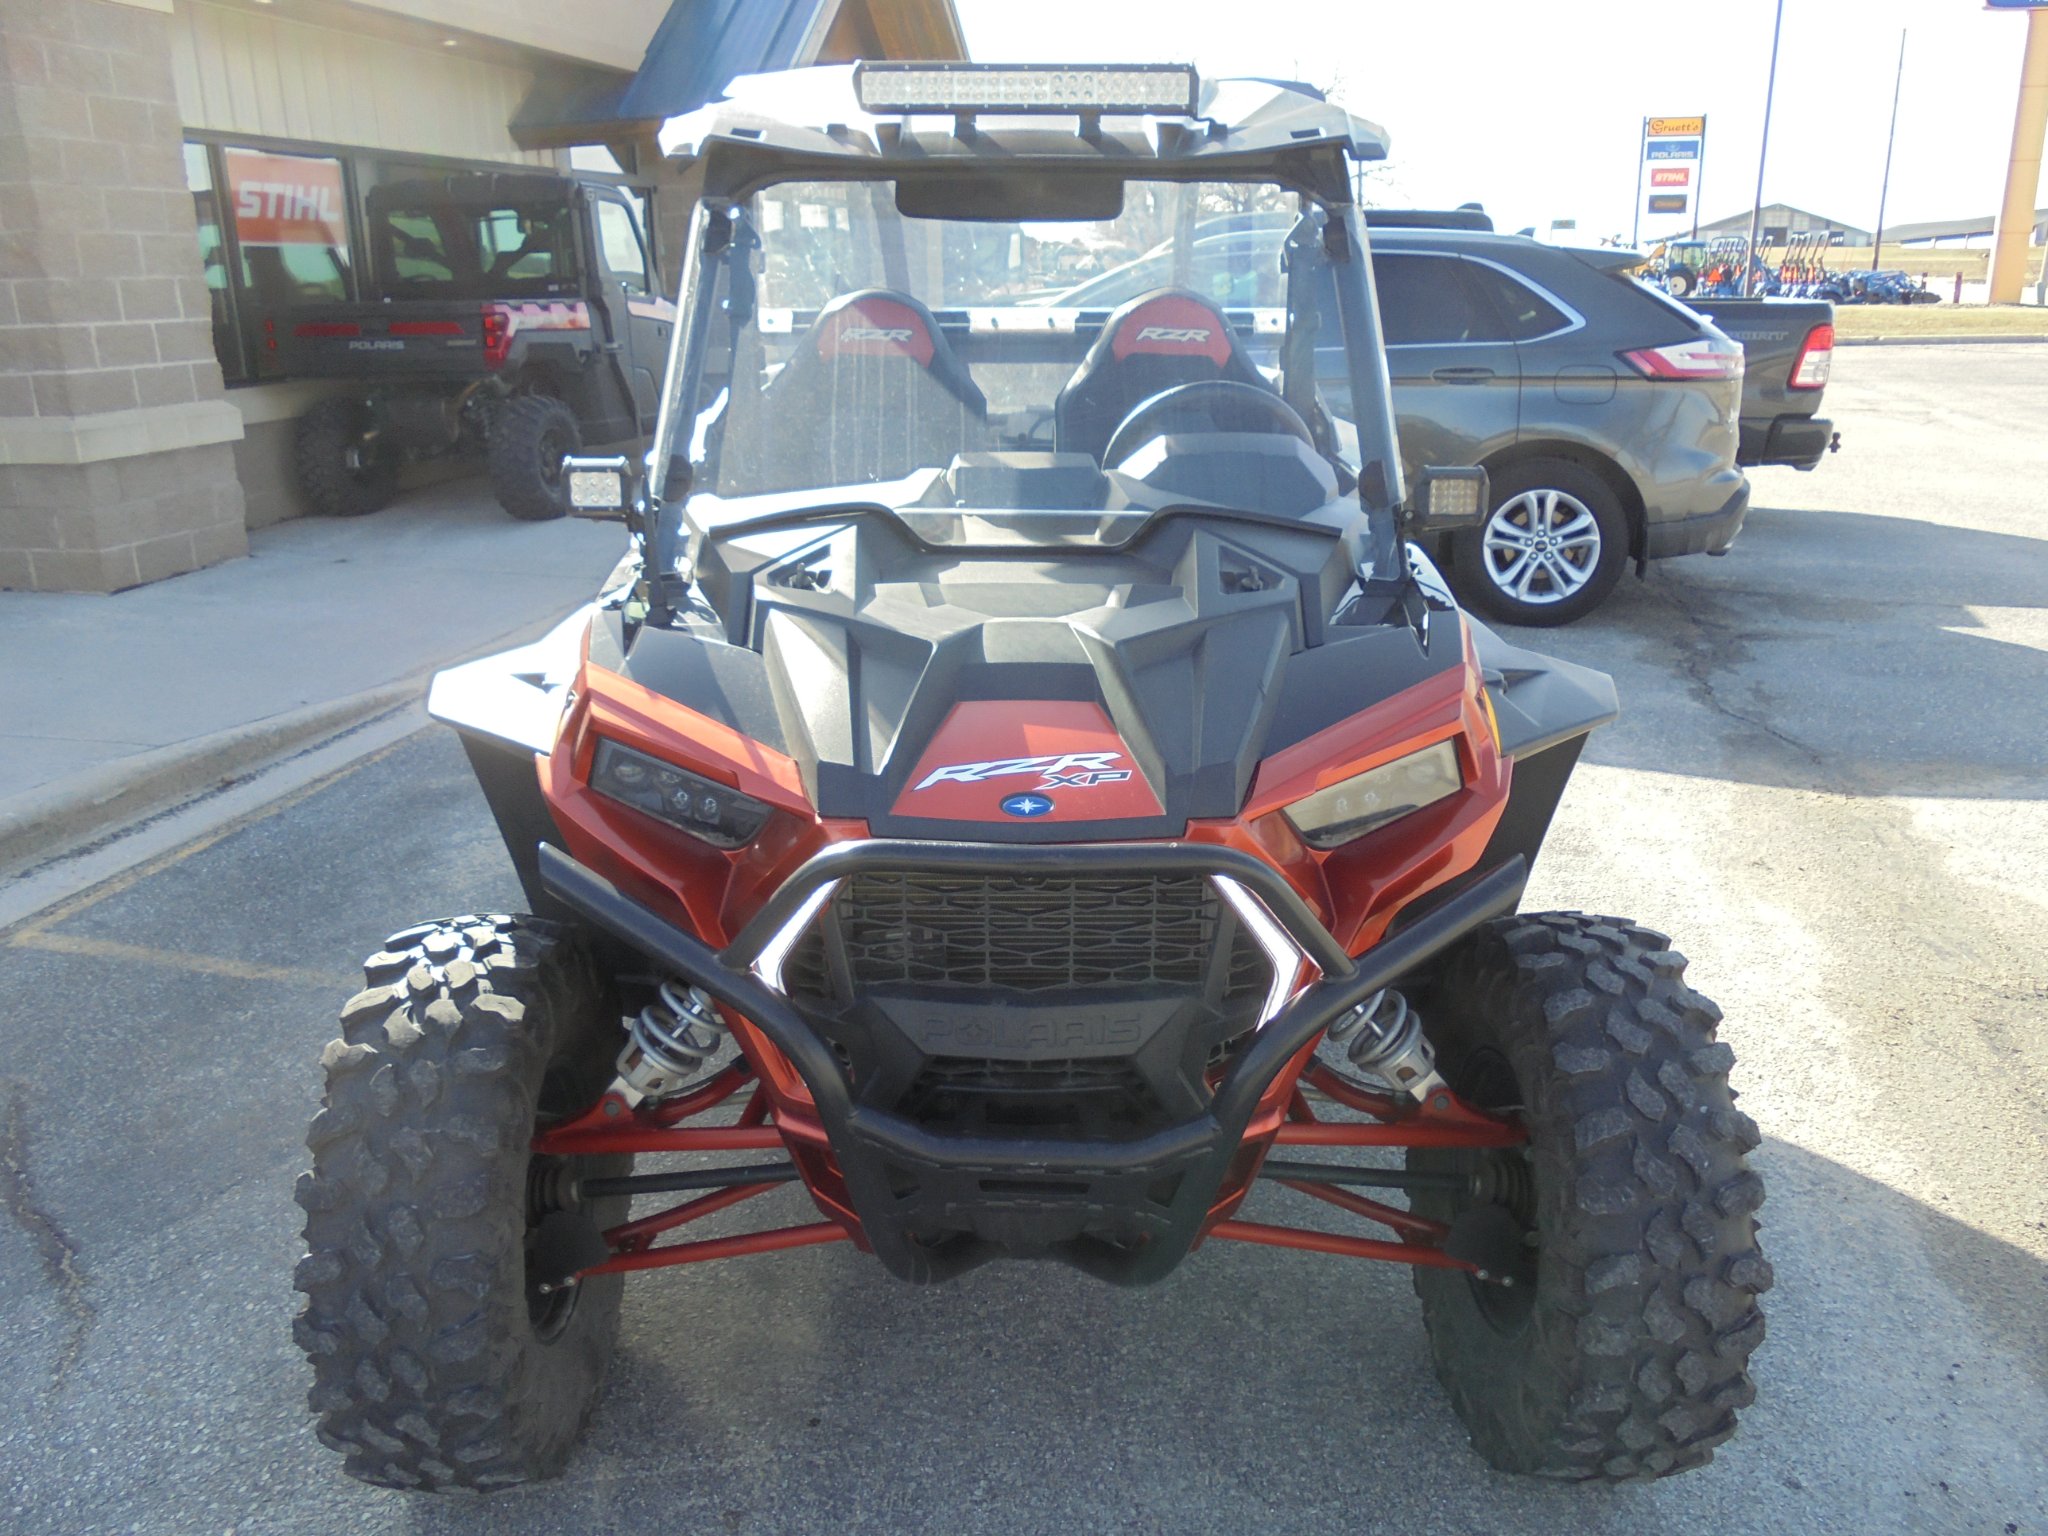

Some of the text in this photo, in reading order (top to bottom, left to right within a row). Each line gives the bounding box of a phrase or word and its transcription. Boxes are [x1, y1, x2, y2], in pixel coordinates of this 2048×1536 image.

[1651, 119, 1699, 134] Gruett's
[1654, 172, 1686, 183] STIHL
[237, 181, 340, 222] STIHL
[840, 327, 913, 343] RZR
[1135, 326, 1211, 342] RZR
[348, 340, 405, 350] POLARIS
[912, 752, 1123, 792] RZR
[1032, 770, 1132, 791] XP
[920, 1012, 1142, 1050] POLARIS
